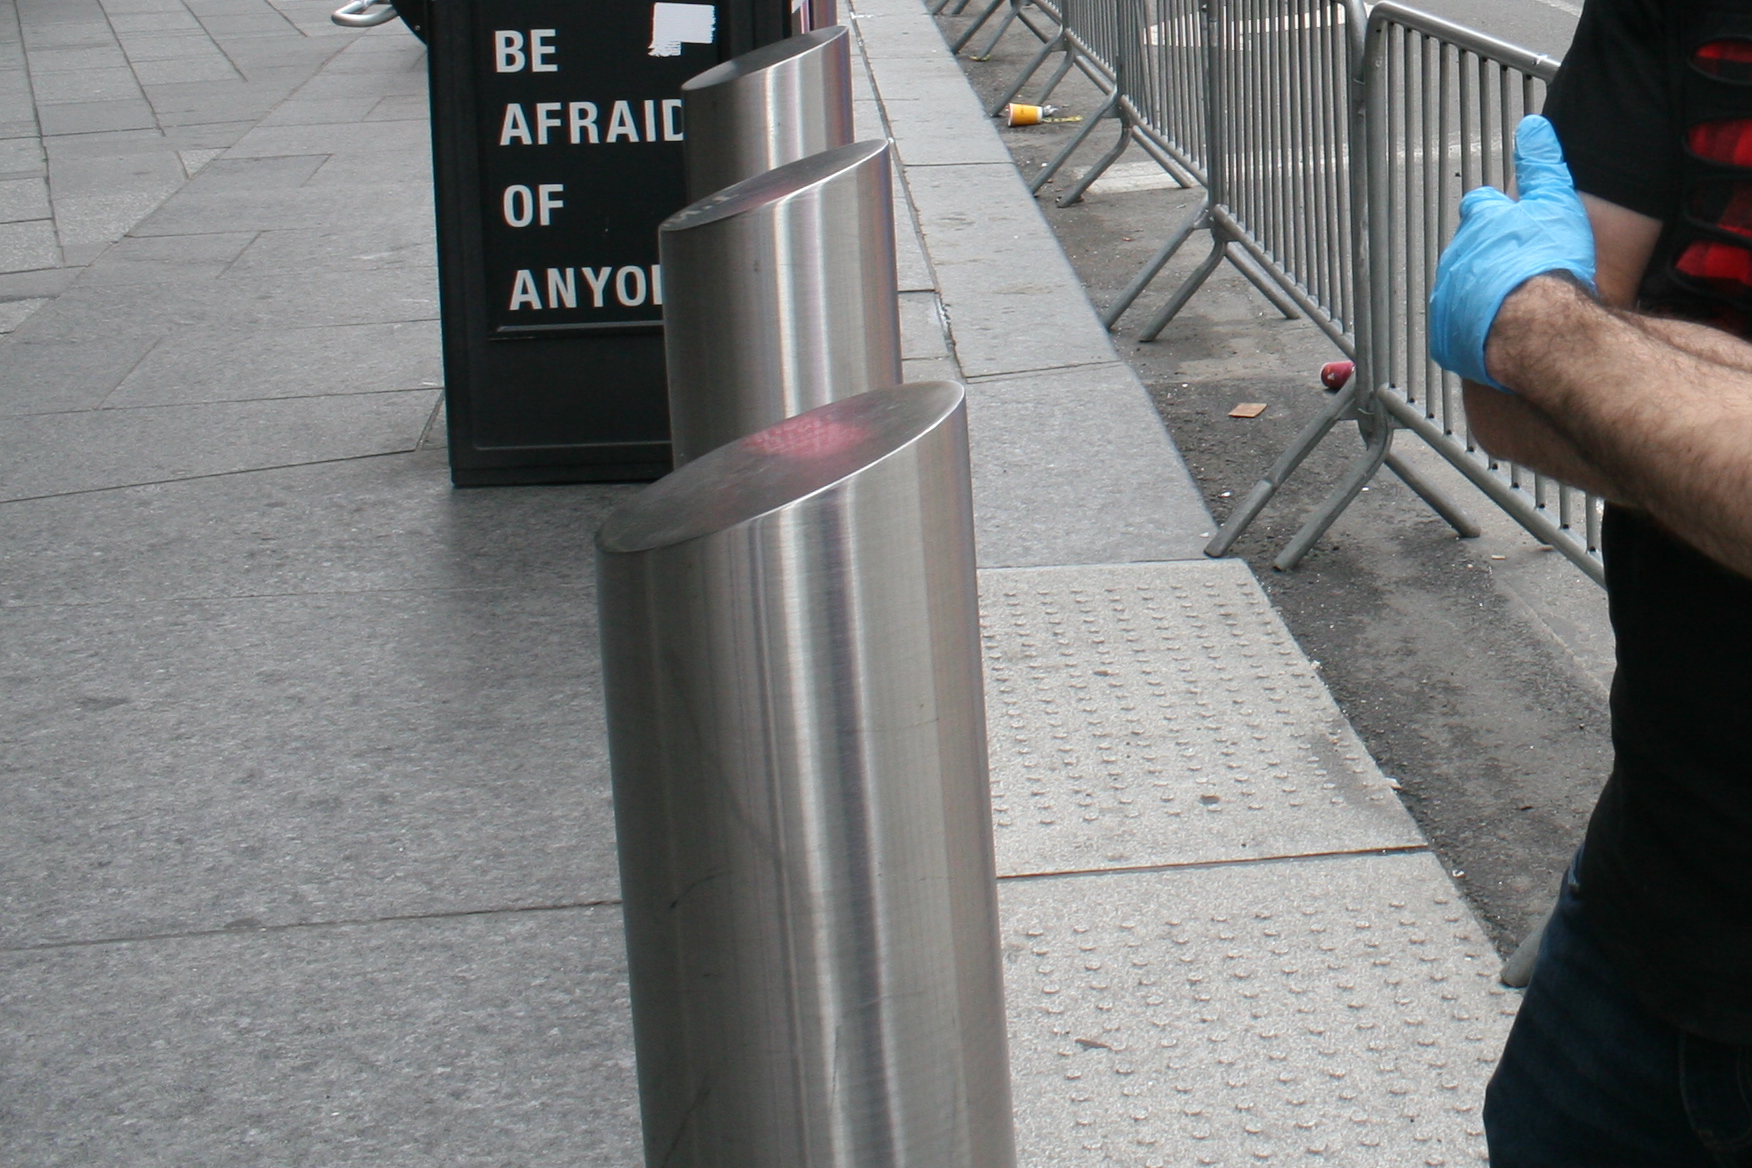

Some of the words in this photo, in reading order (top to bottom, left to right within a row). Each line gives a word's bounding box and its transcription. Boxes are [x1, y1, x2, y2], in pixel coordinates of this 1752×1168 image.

[494, 29, 559, 73] BE
[499, 98, 684, 146] AFRAID
[503, 183, 564, 227] OF
[509, 263, 664, 311] ANYO
